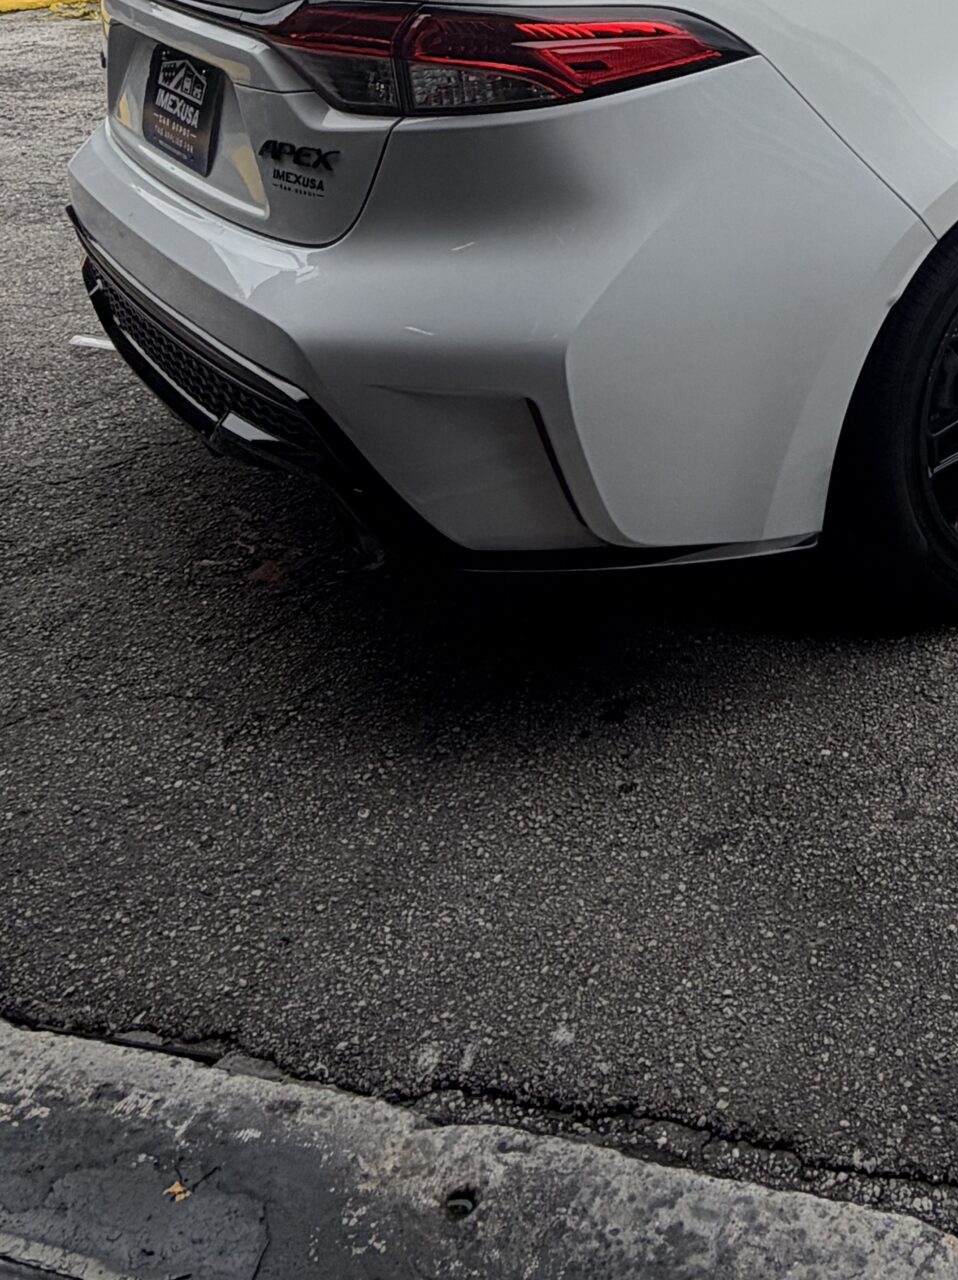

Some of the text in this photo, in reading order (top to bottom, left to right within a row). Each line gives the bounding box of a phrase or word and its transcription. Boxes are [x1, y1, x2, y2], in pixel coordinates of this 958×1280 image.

[155, 88, 199, 129] IMEXUSA
[258, 139, 341, 172] APEX
[272, 168, 325, 192] IMEXUSA
